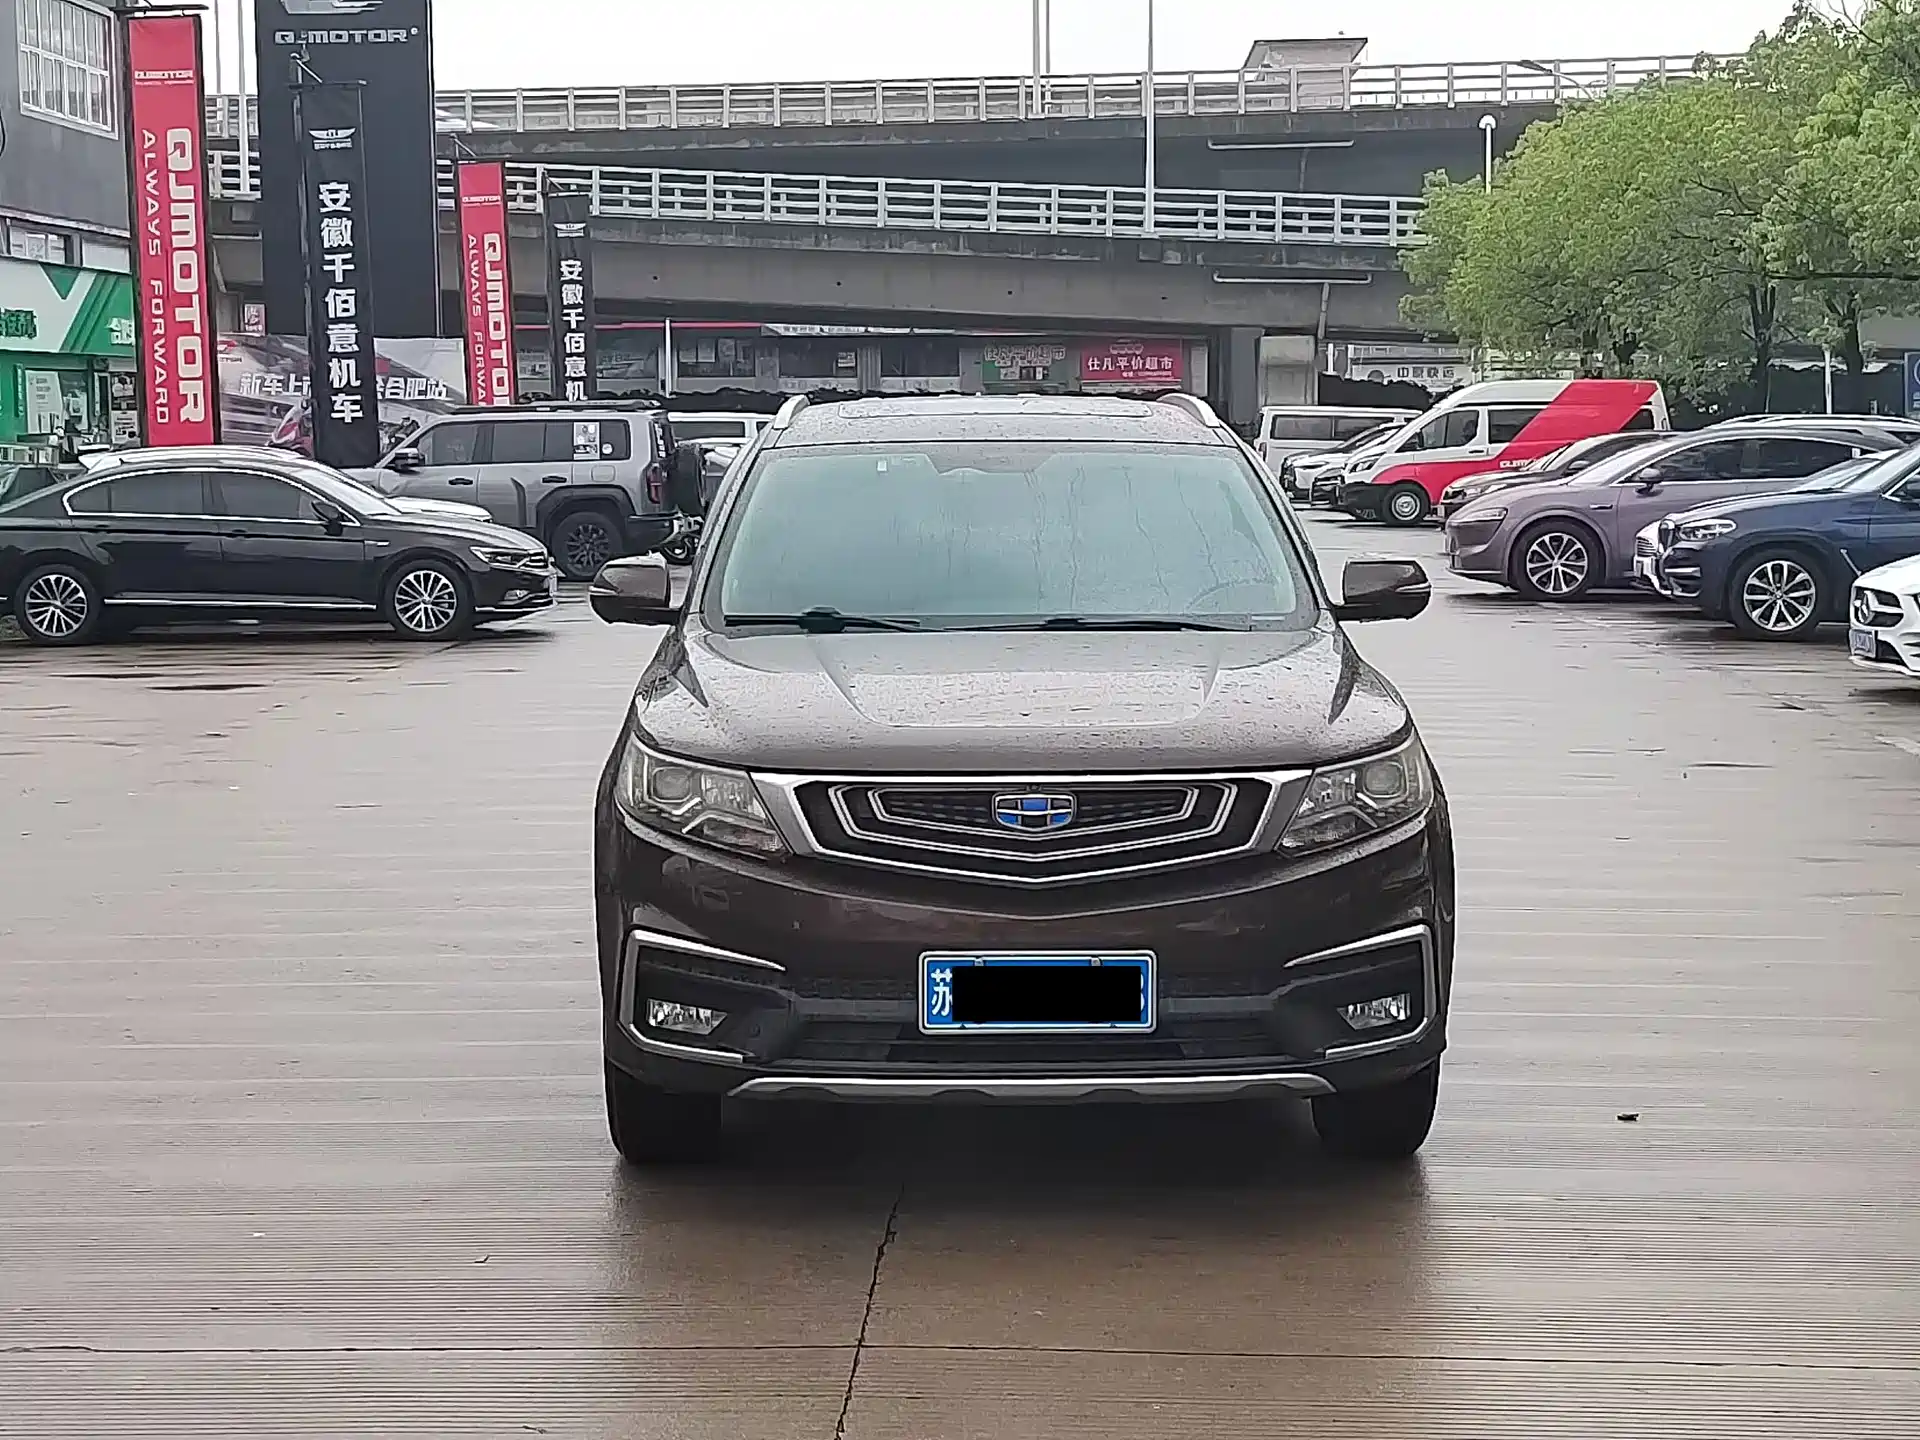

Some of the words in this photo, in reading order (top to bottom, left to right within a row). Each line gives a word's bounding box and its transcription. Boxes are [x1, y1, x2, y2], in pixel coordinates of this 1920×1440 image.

[142, 129, 161, 256] ALWAYS
[166, 128, 205, 422] QJMOTOR
[318, 182, 364, 423] 安徽千佰意机车
[467, 234, 482, 317] ALWAYS
[560, 259, 588, 402] 安徽千佰意机
[150, 279, 169, 423] FORWARD
[474, 331, 487, 405] FORWA
